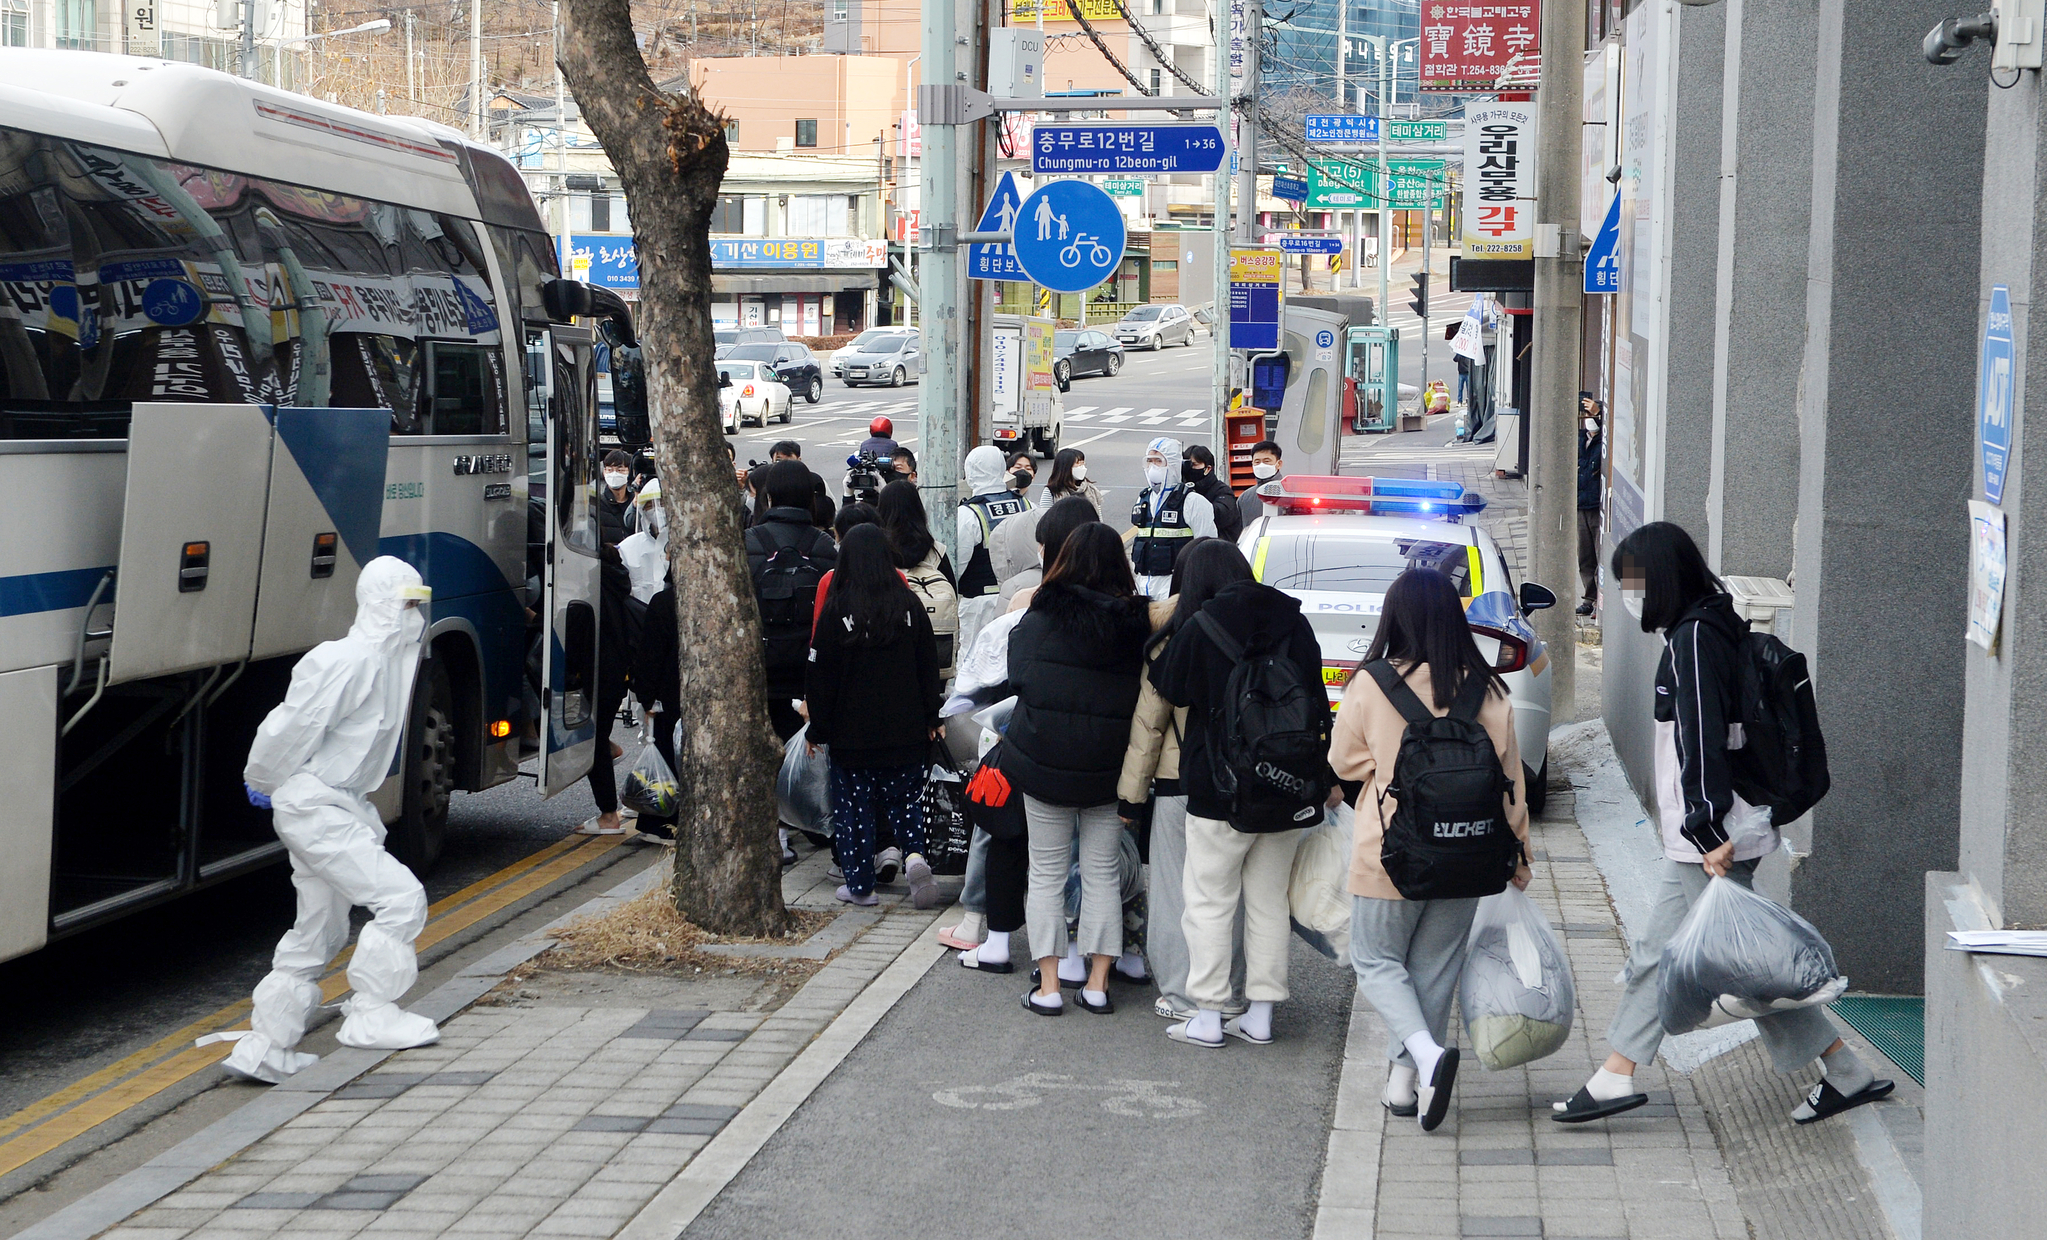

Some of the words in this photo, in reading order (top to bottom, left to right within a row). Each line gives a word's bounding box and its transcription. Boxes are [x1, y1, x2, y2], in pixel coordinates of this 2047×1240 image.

[1022, 40, 1039, 52] DCU
[1424, 64, 1458, 76] 철학관
[1461, 66, 1509, 76] T.254-836
[1470, 112, 1489, 126] 사무용
[1490, 110, 1509, 120] 가구의
[1509, 111, 1529, 125] 모든것
[1308, 128, 1367, 138] 제2노인전문병원
[1391, 125, 1444, 138] 테미삼거리
[1038, 131, 1155, 153] 충무로12번길
[1038, 156, 1110, 171] Chungmu-ro
[1114, 155, 1178, 170] 12beon-gil
[1476, 125, 1520, 202] 우리사무용
[1104, 181, 1142, 190] 테미삼거리
[1397, 178, 1415, 189] 금산
[1477, 207, 1519, 236] 가구
[721, 242, 759, 260] 기산
[763, 242, 818, 260] 이용원
[1471, 244, 1485, 252] Tel.
[1487, 244, 1522, 253] 222-8258
[1240, 256, 1275, 266] 버스승강장
[992, 502, 1017, 516] 경찰
[1155, 1005, 1174, 1018] crocs
